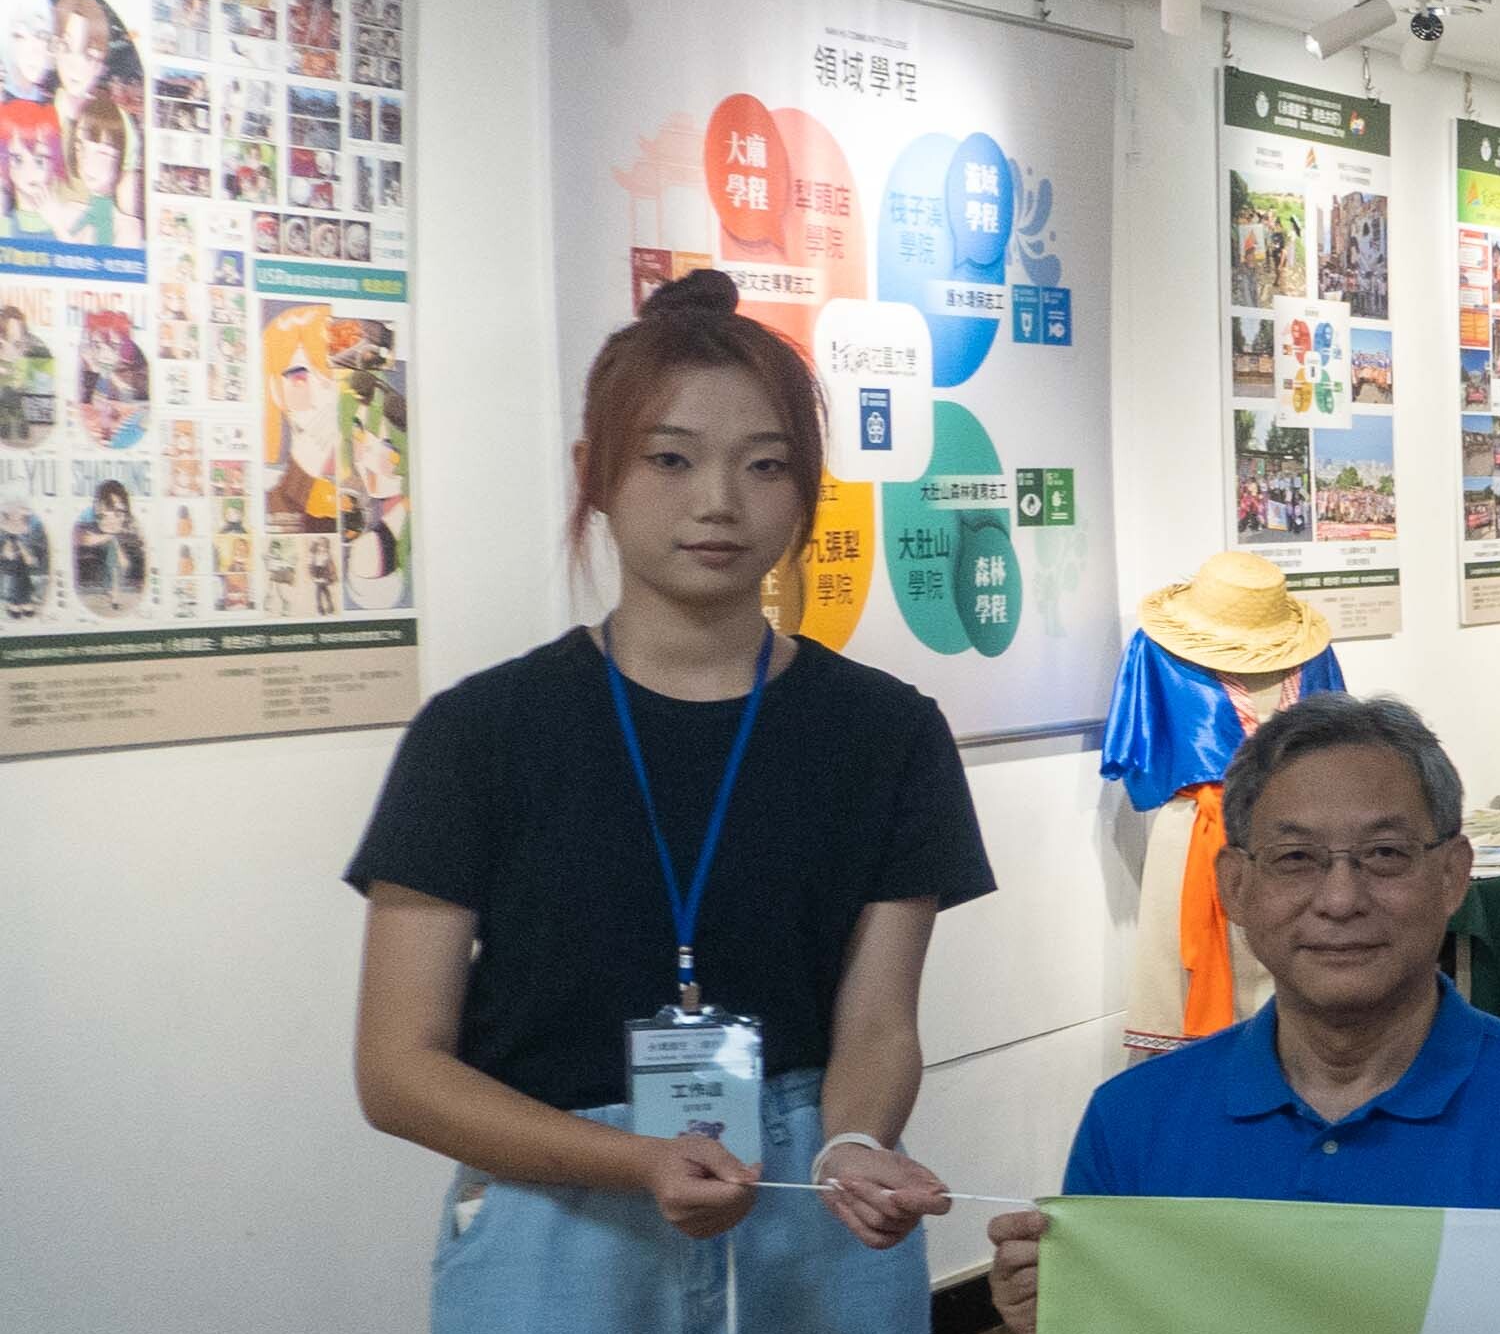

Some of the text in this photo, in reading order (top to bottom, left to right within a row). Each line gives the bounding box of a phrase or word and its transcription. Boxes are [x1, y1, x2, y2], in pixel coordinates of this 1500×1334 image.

[814, 45, 918, 103] 領域學程
[726, 174, 768, 212] 學程
[806, 224, 846, 260] 學院
[899, 231, 935, 265] 學院
[898, 529, 951, 561] 大肚山
[908, 571, 943, 601] 學院
[974, 556, 1007, 587] 森林
[817, 573, 854, 607] 學院
[975, 594, 1008, 624] 學程
